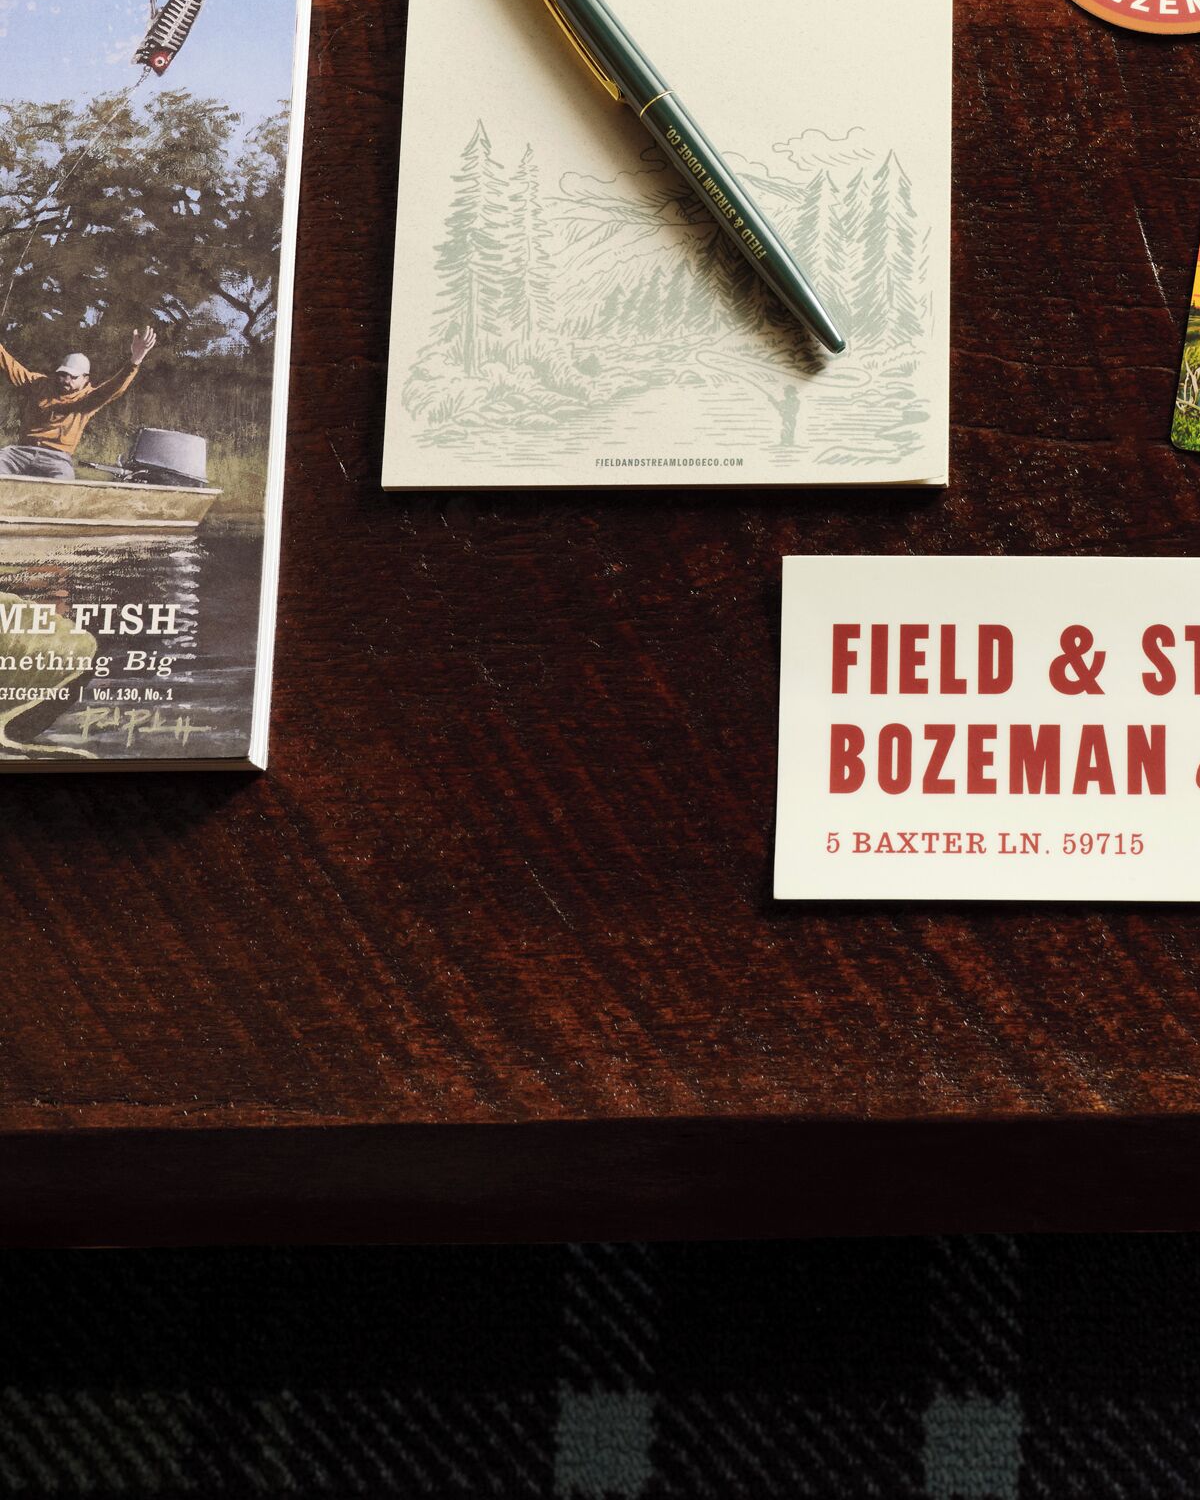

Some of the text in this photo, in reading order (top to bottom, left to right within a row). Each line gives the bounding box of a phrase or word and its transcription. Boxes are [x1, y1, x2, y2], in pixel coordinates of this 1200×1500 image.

[676, 143, 709, 182] LODGE
[698, 177, 737, 218] STREAM
[733, 216, 745, 230] &
[741, 228, 768, 260] FIELD
[595, 458, 745, 468] FIELDANDSTREAMLODGECO.COM
[70, 603, 181, 635] FISH
[123, 650, 177, 677] Big
[831, 623, 1015, 696] FIELD
[1048, 623, 1108, 696] &
[93, 688, 174, 703] Vol. 130, No. 1
[829, 723, 1168, 796] BOZEMAN
[826, 832, 1146, 856] 5 BAXTER LN. 59715
